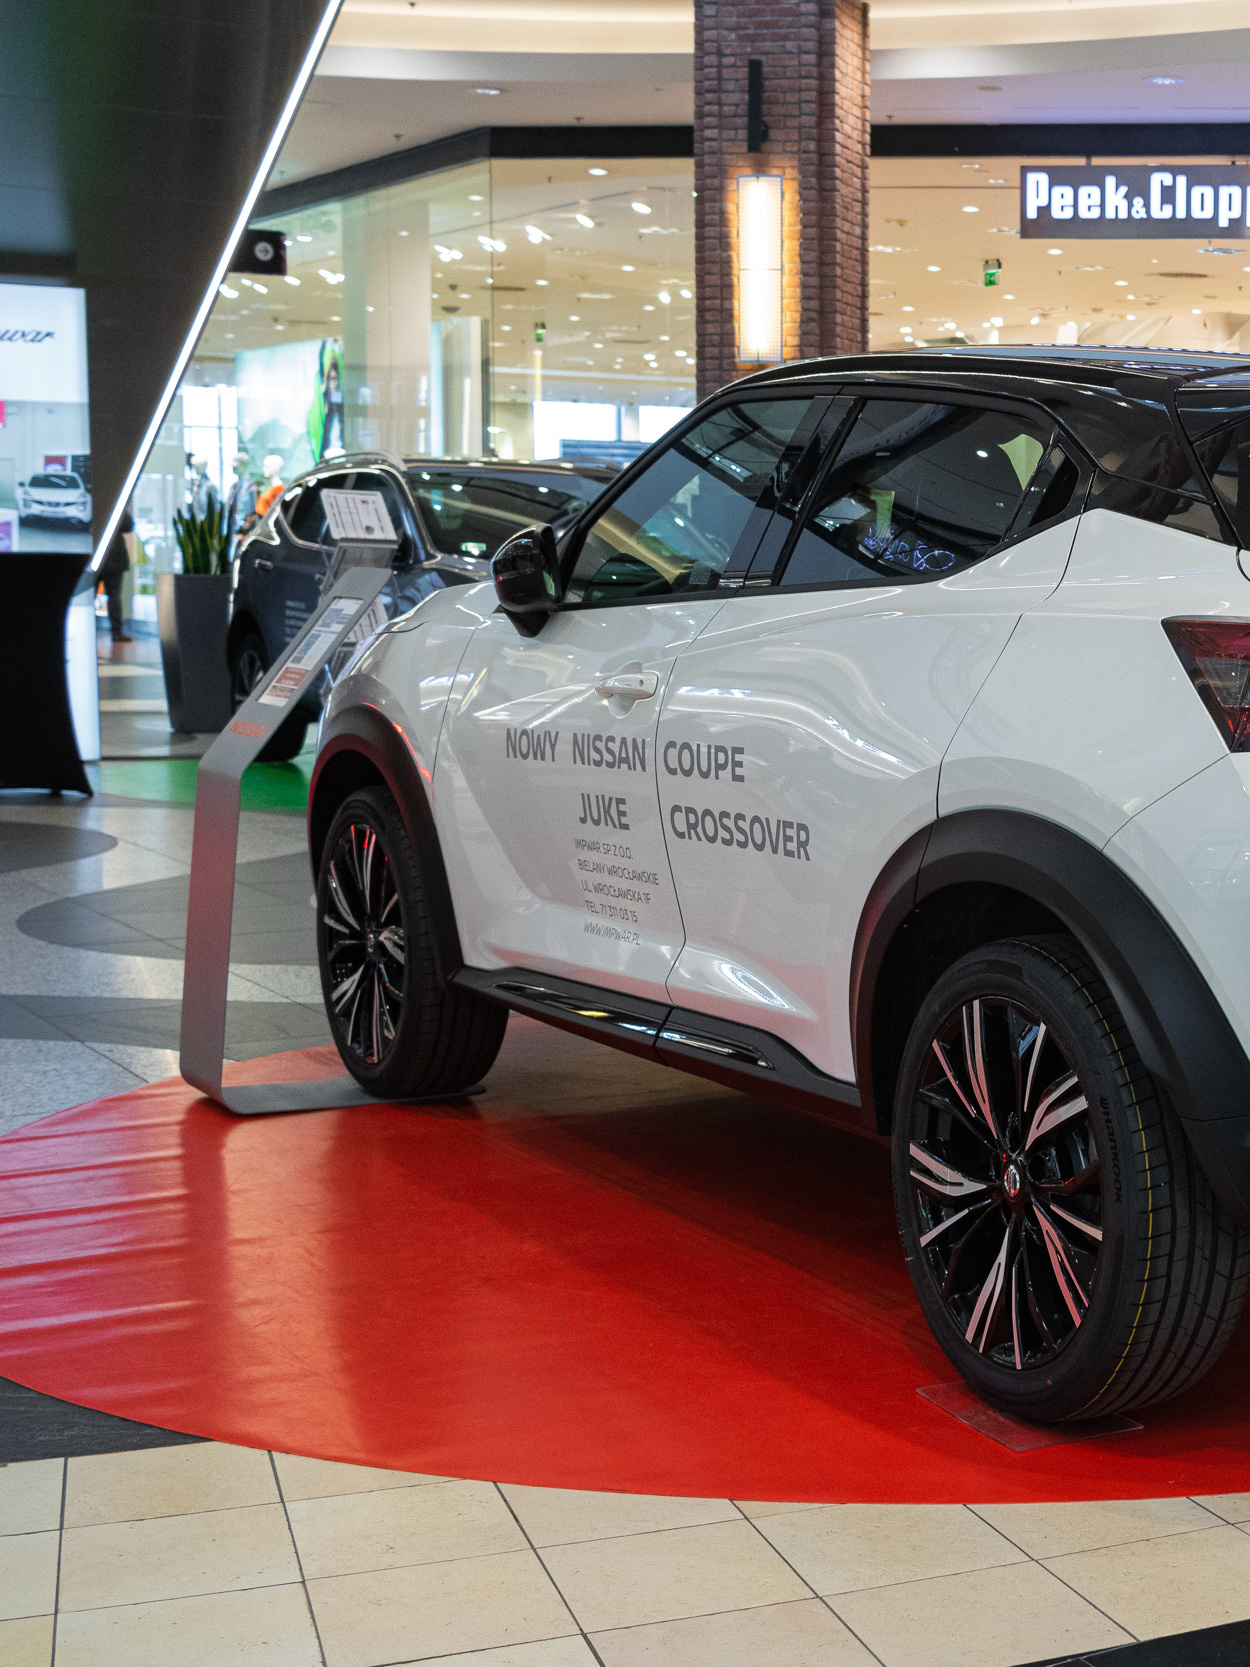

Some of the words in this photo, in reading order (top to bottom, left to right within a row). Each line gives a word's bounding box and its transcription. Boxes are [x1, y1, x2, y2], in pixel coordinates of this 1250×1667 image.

[506, 727, 560, 762] NOWY
[572, 732, 647, 773] NISSAN
[663, 740, 745, 783] COUPE
[579, 792, 630, 831] JUKE
[669, 804, 811, 862] CROSSOVER
[577, 858, 606, 875] BIELANY
[599, 903, 608, 916] 71
[608, 905, 619, 919] 311
[619, 907, 630, 921] 03
[629, 910, 639, 923] 15
